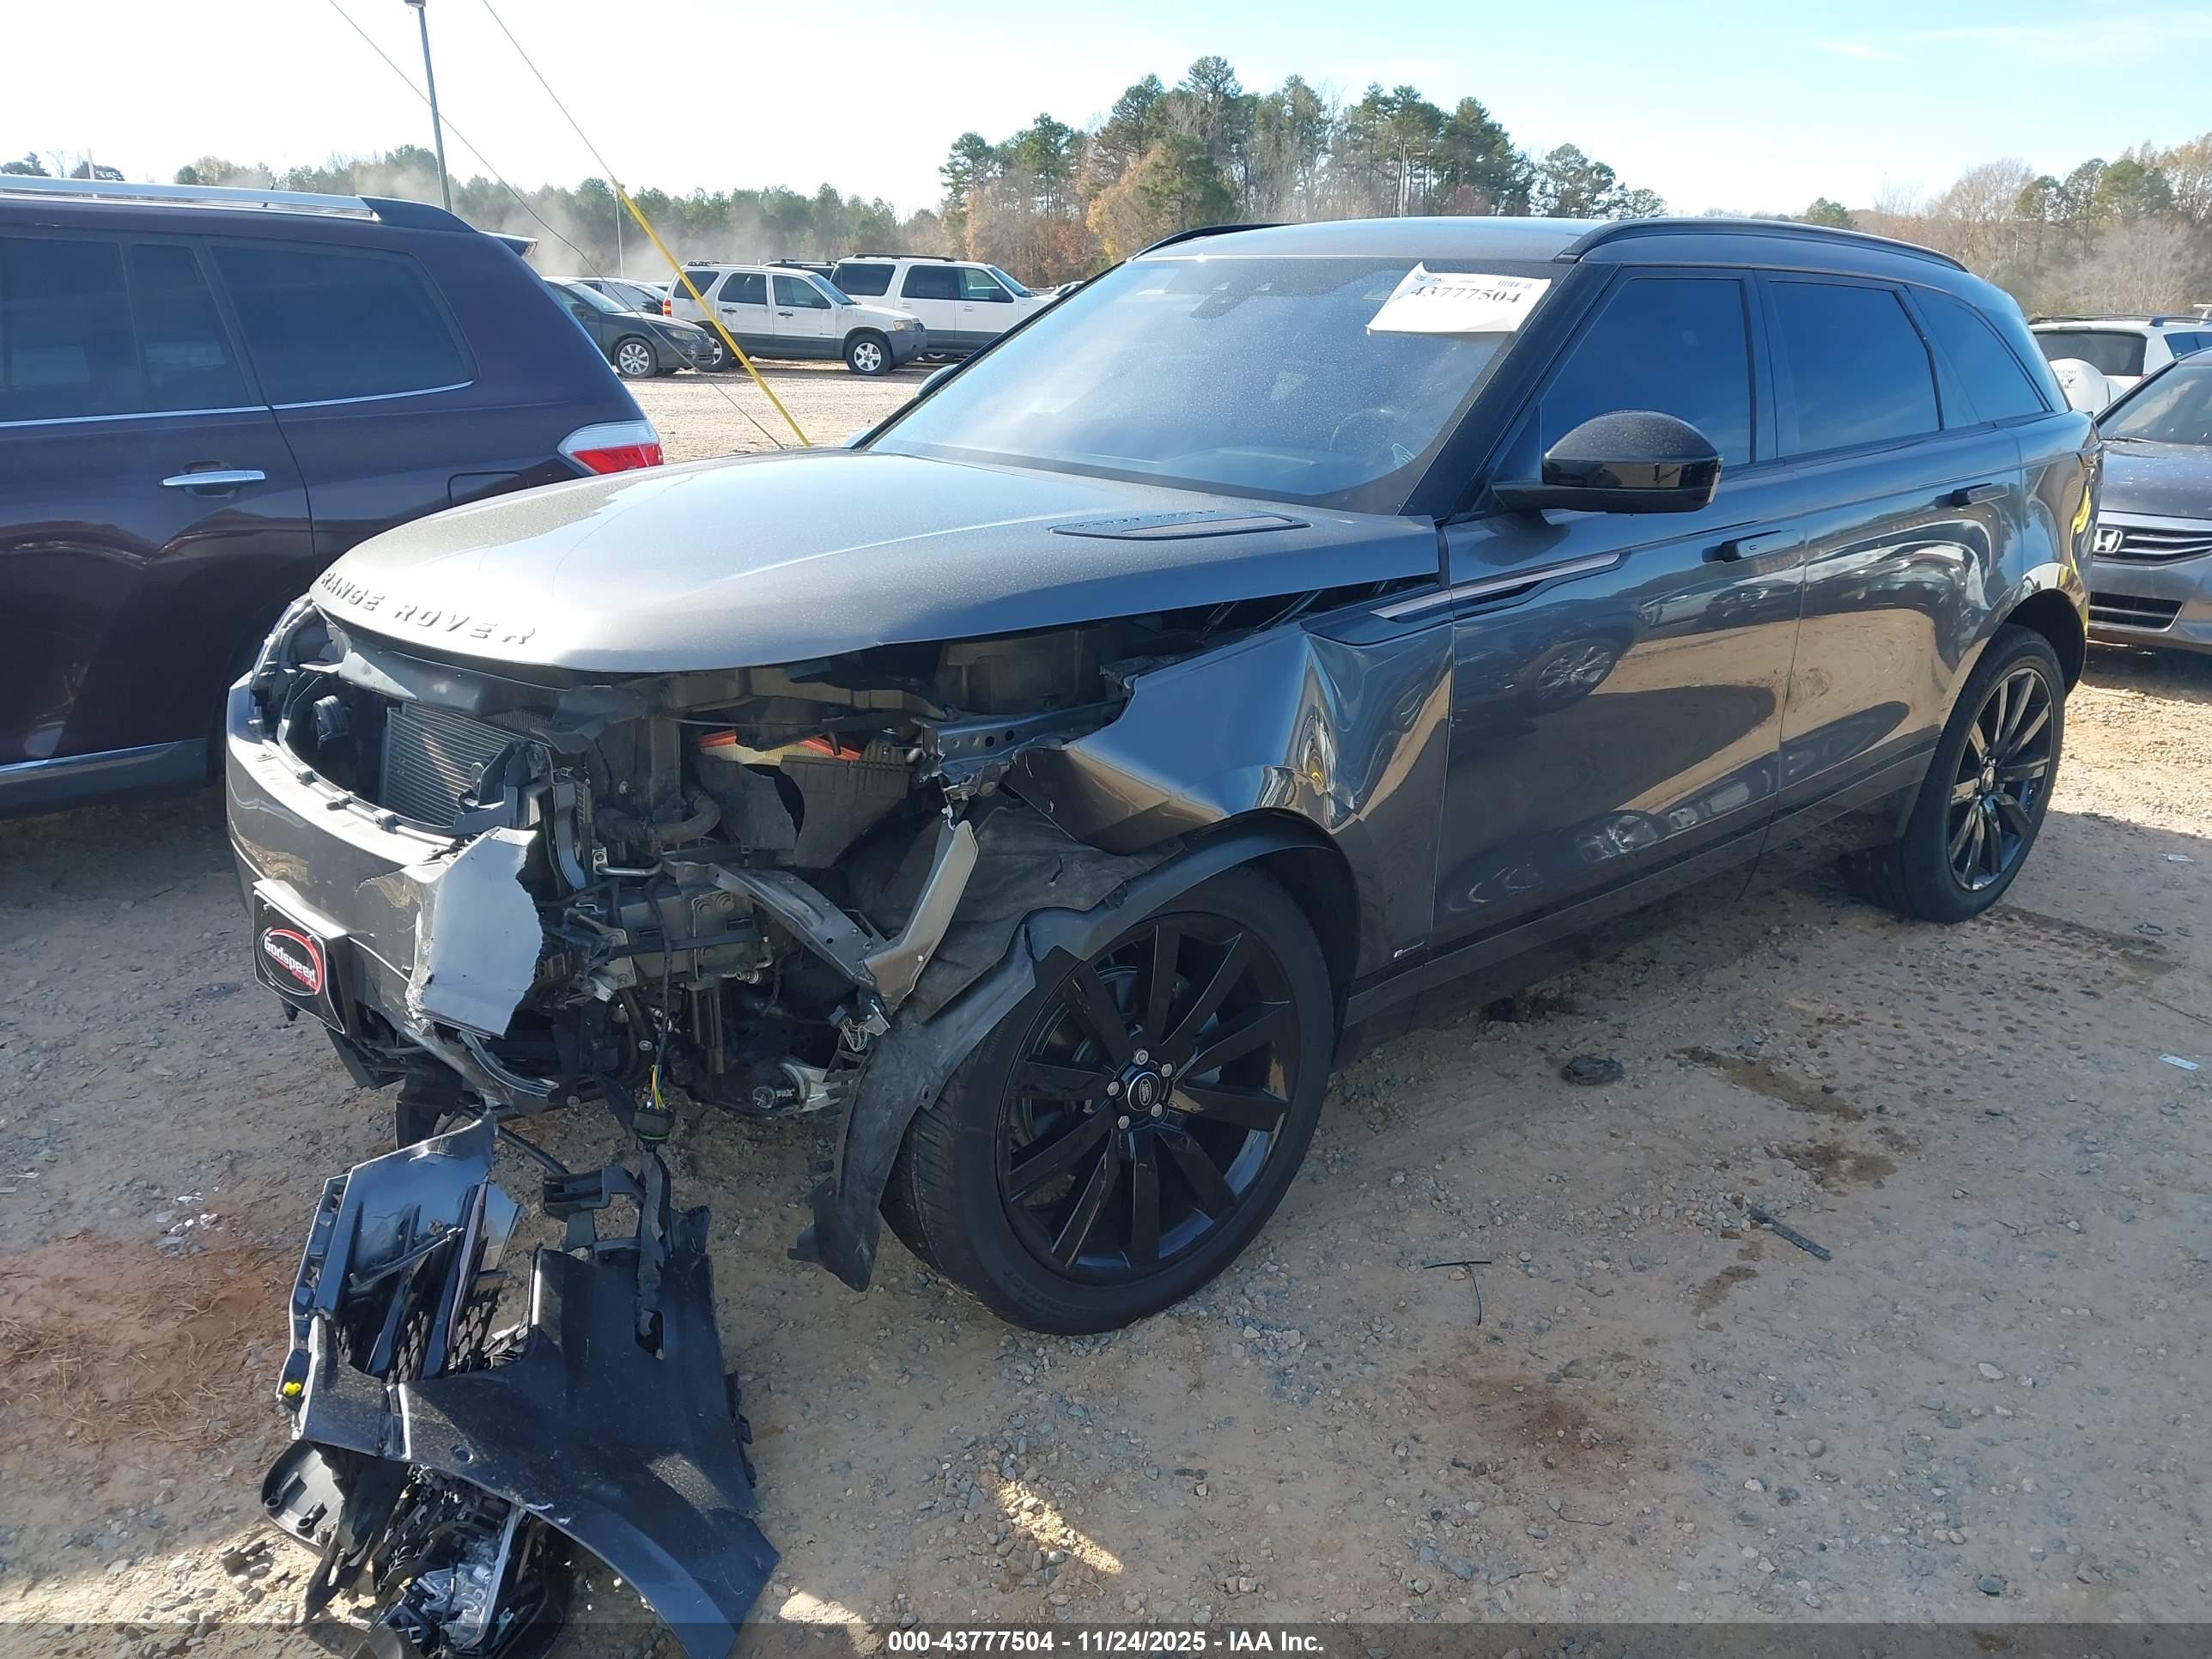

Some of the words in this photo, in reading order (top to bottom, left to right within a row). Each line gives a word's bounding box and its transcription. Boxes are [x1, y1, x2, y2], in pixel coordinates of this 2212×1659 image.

[1410, 285, 1522, 303] 43777504
[319, 571, 386, 611] RANGE
[393, 605, 537, 645] ROVER
[264, 935, 316, 982] Godspeed
